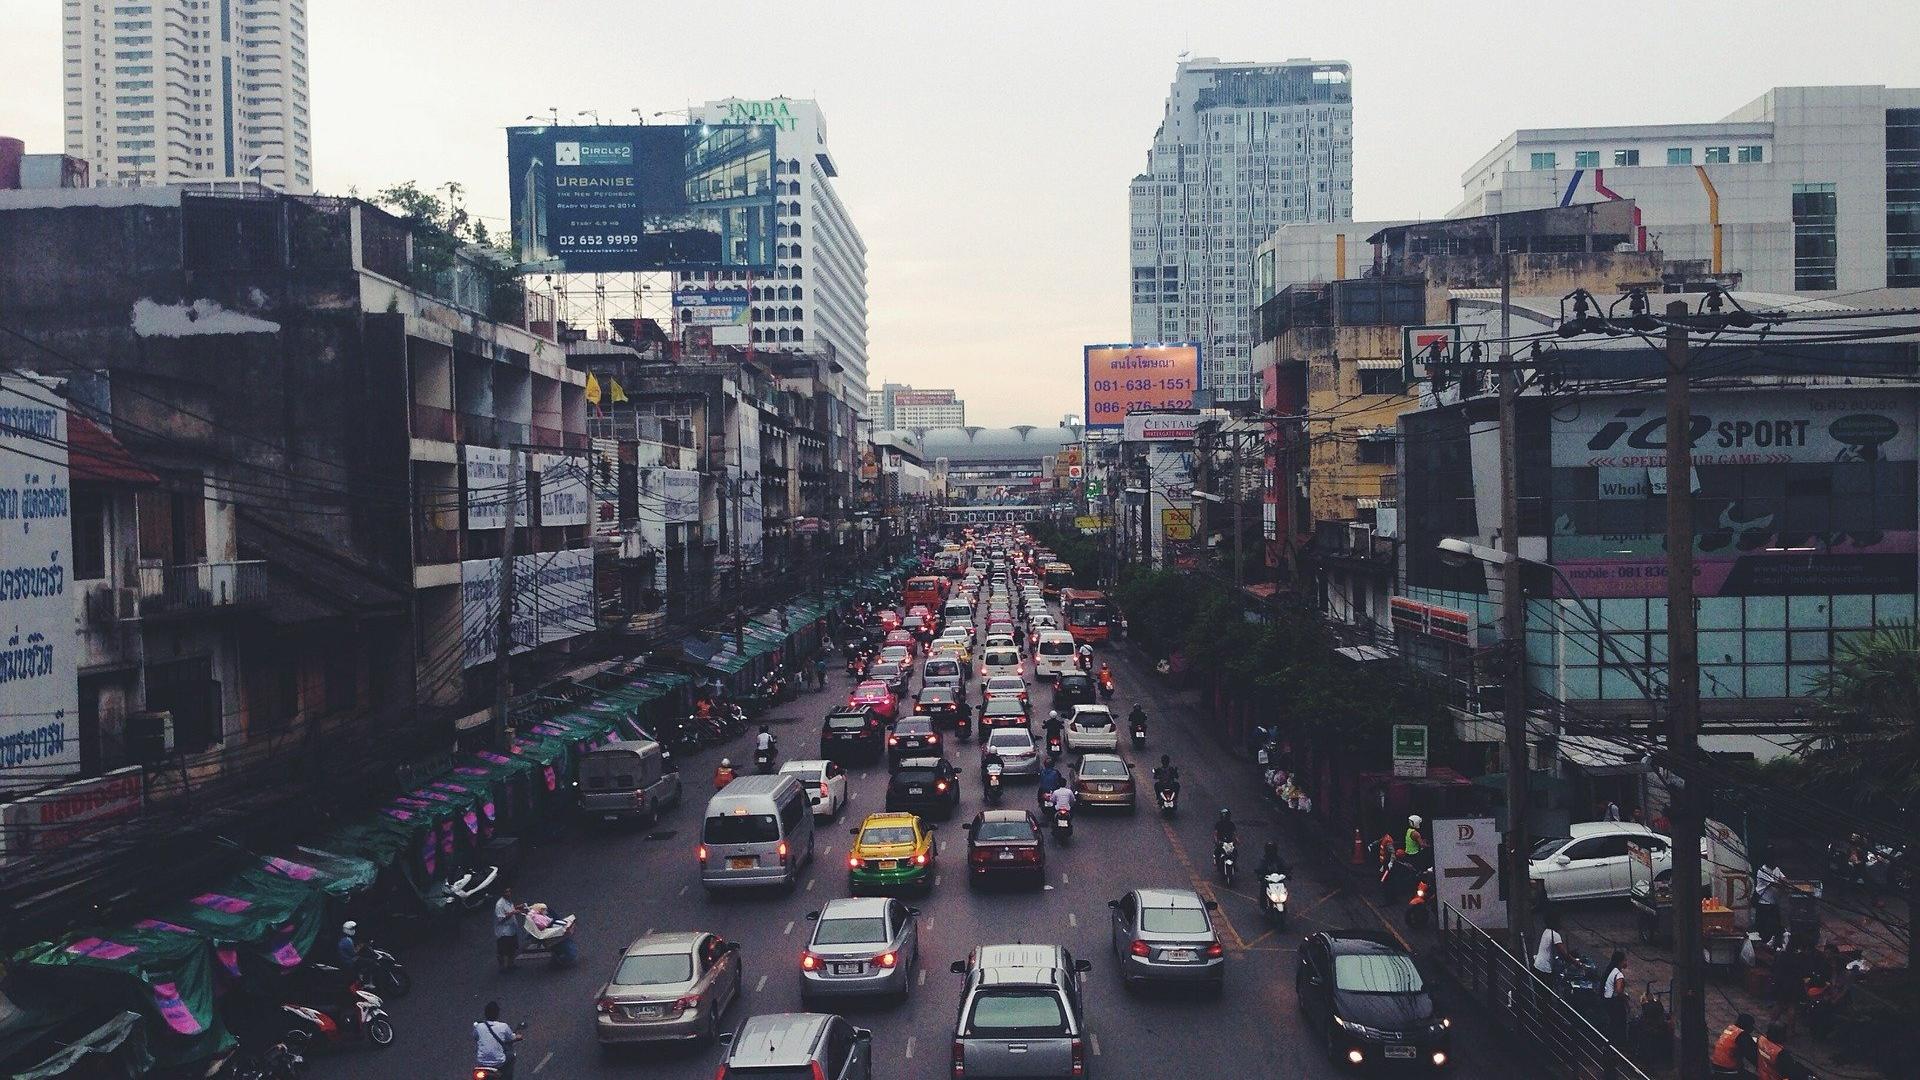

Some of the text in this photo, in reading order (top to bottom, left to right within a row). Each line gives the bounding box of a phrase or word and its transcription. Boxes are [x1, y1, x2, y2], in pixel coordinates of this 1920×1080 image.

[730, 103, 790, 117] INDRA
[556, 176, 634, 187] URBANISE
[560, 235, 639, 246] 02 652 9999
[1110, 355, 1175, 370] สนใจโฆษณา
[1094, 378, 1191, 392] 081-638-1551
[1094, 400, 1193, 413] 086-376-1522
[1716, 419, 1810, 449] SPORT
[1718, 454, 1762, 465] GAME
[1618, 566, 1641, 579] 081
[1461, 894, 1483, 910] IN
